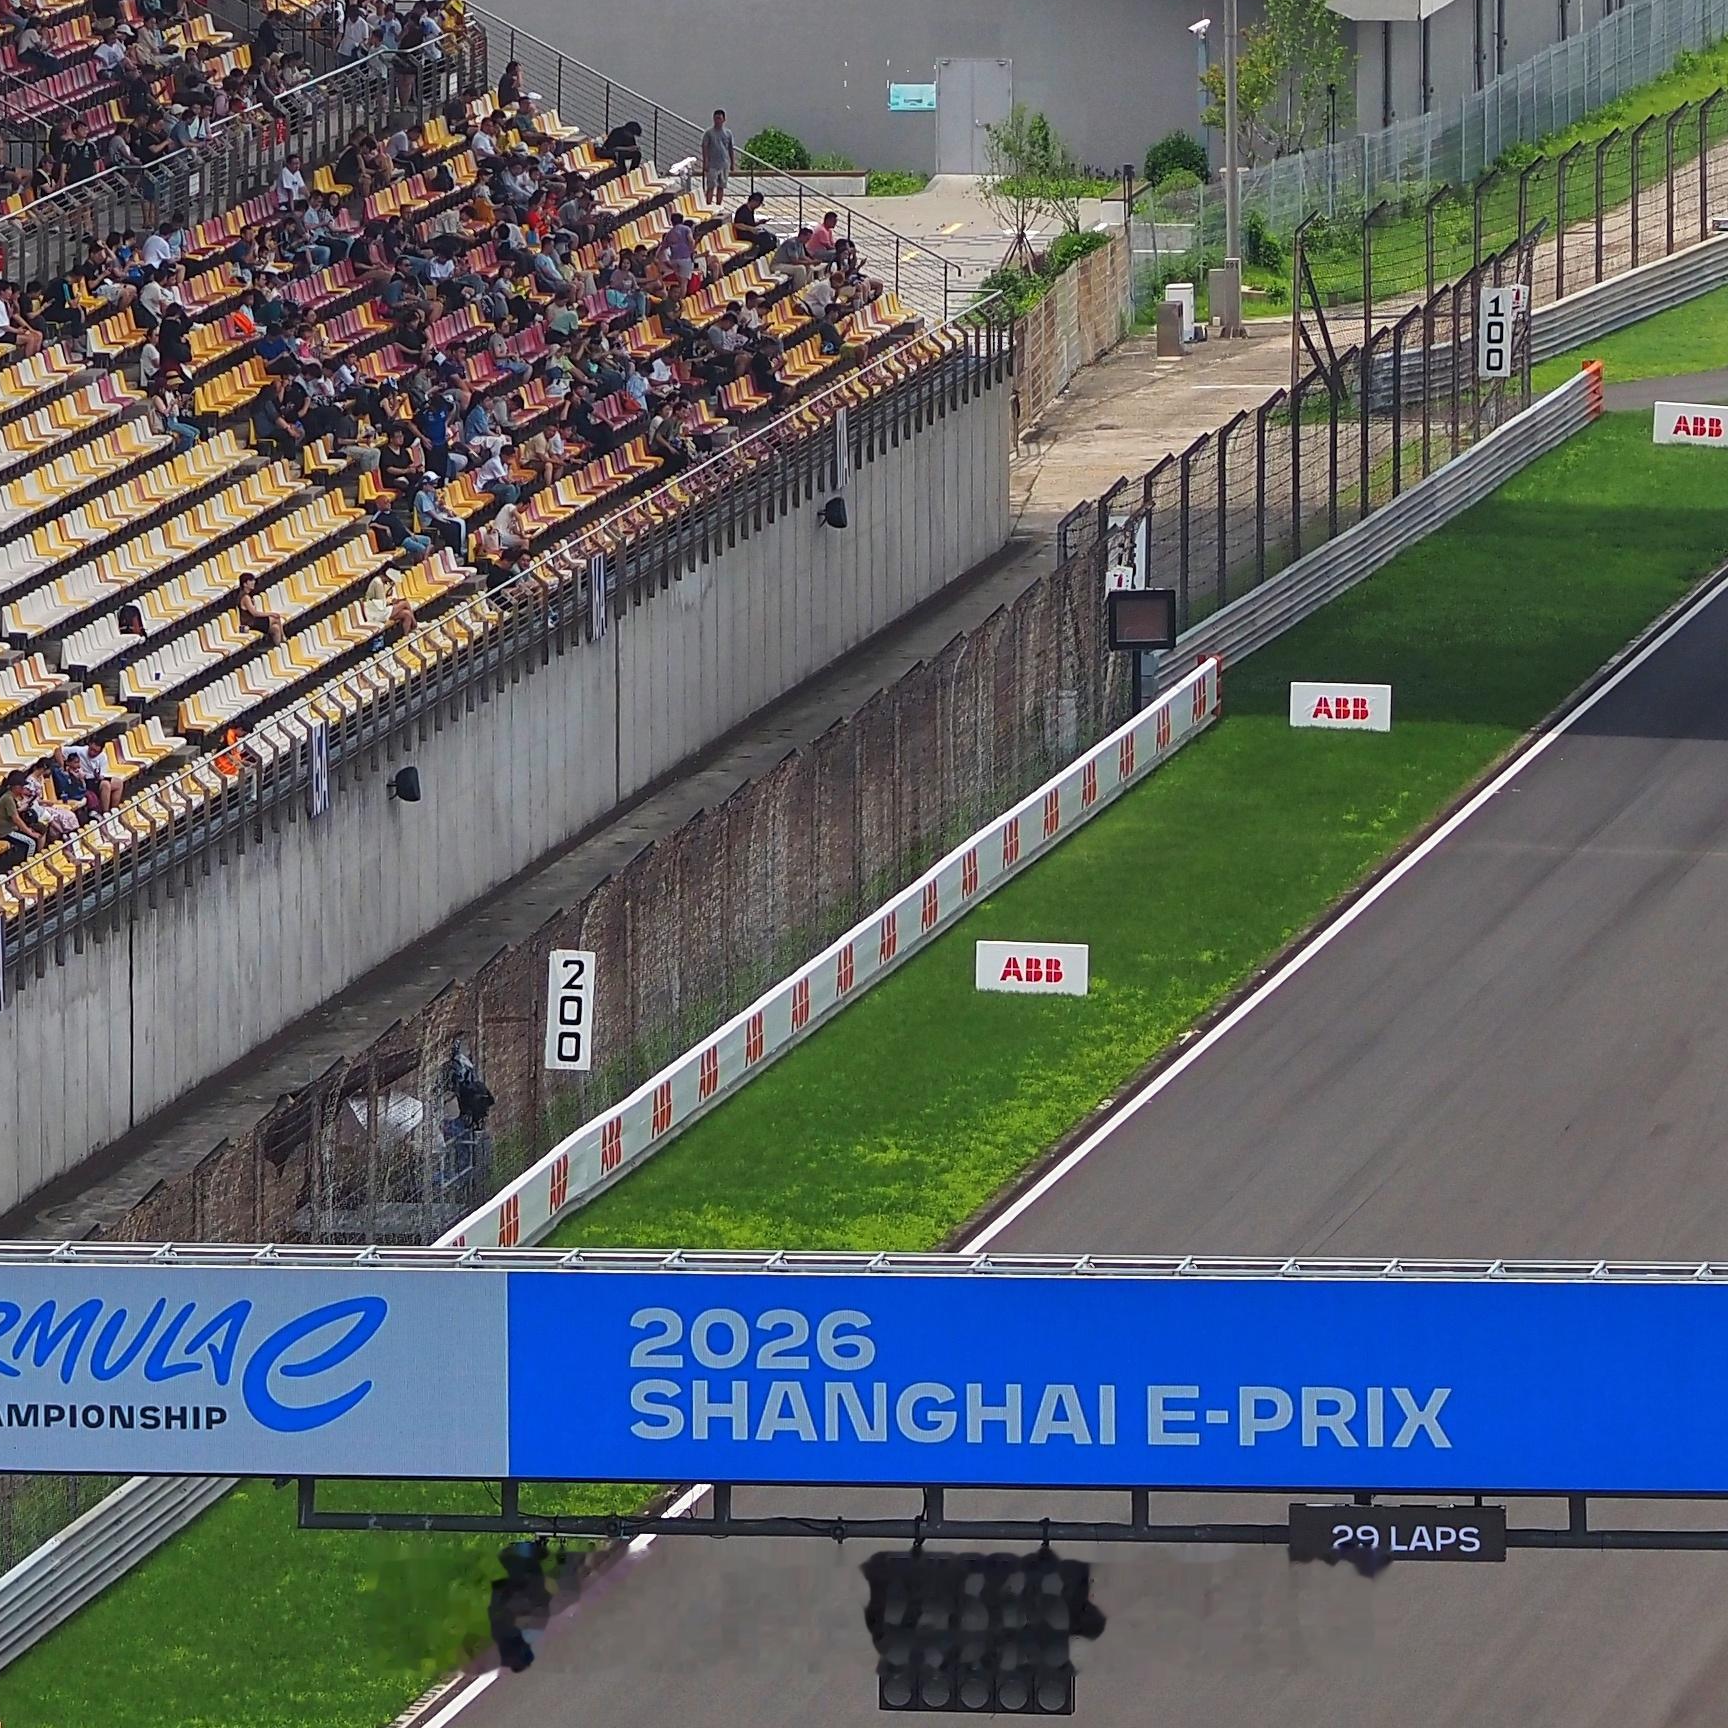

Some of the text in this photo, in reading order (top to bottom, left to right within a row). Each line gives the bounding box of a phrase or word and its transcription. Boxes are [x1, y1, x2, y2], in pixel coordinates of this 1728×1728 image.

[1486, 295, 1504, 371] 100
[1673, 415, 1724, 439] ABB
[1312, 696, 1370, 721] ABB
[999, 955, 1064, 985] ABB
[557, 959, 585, 1062] 200
[629, 1306, 877, 1372] 2026
[629, 1378, 1452, 1450] SHANGHAI E-PRIX
[1331, 1525, 1481, 1552] 29 LAPS
